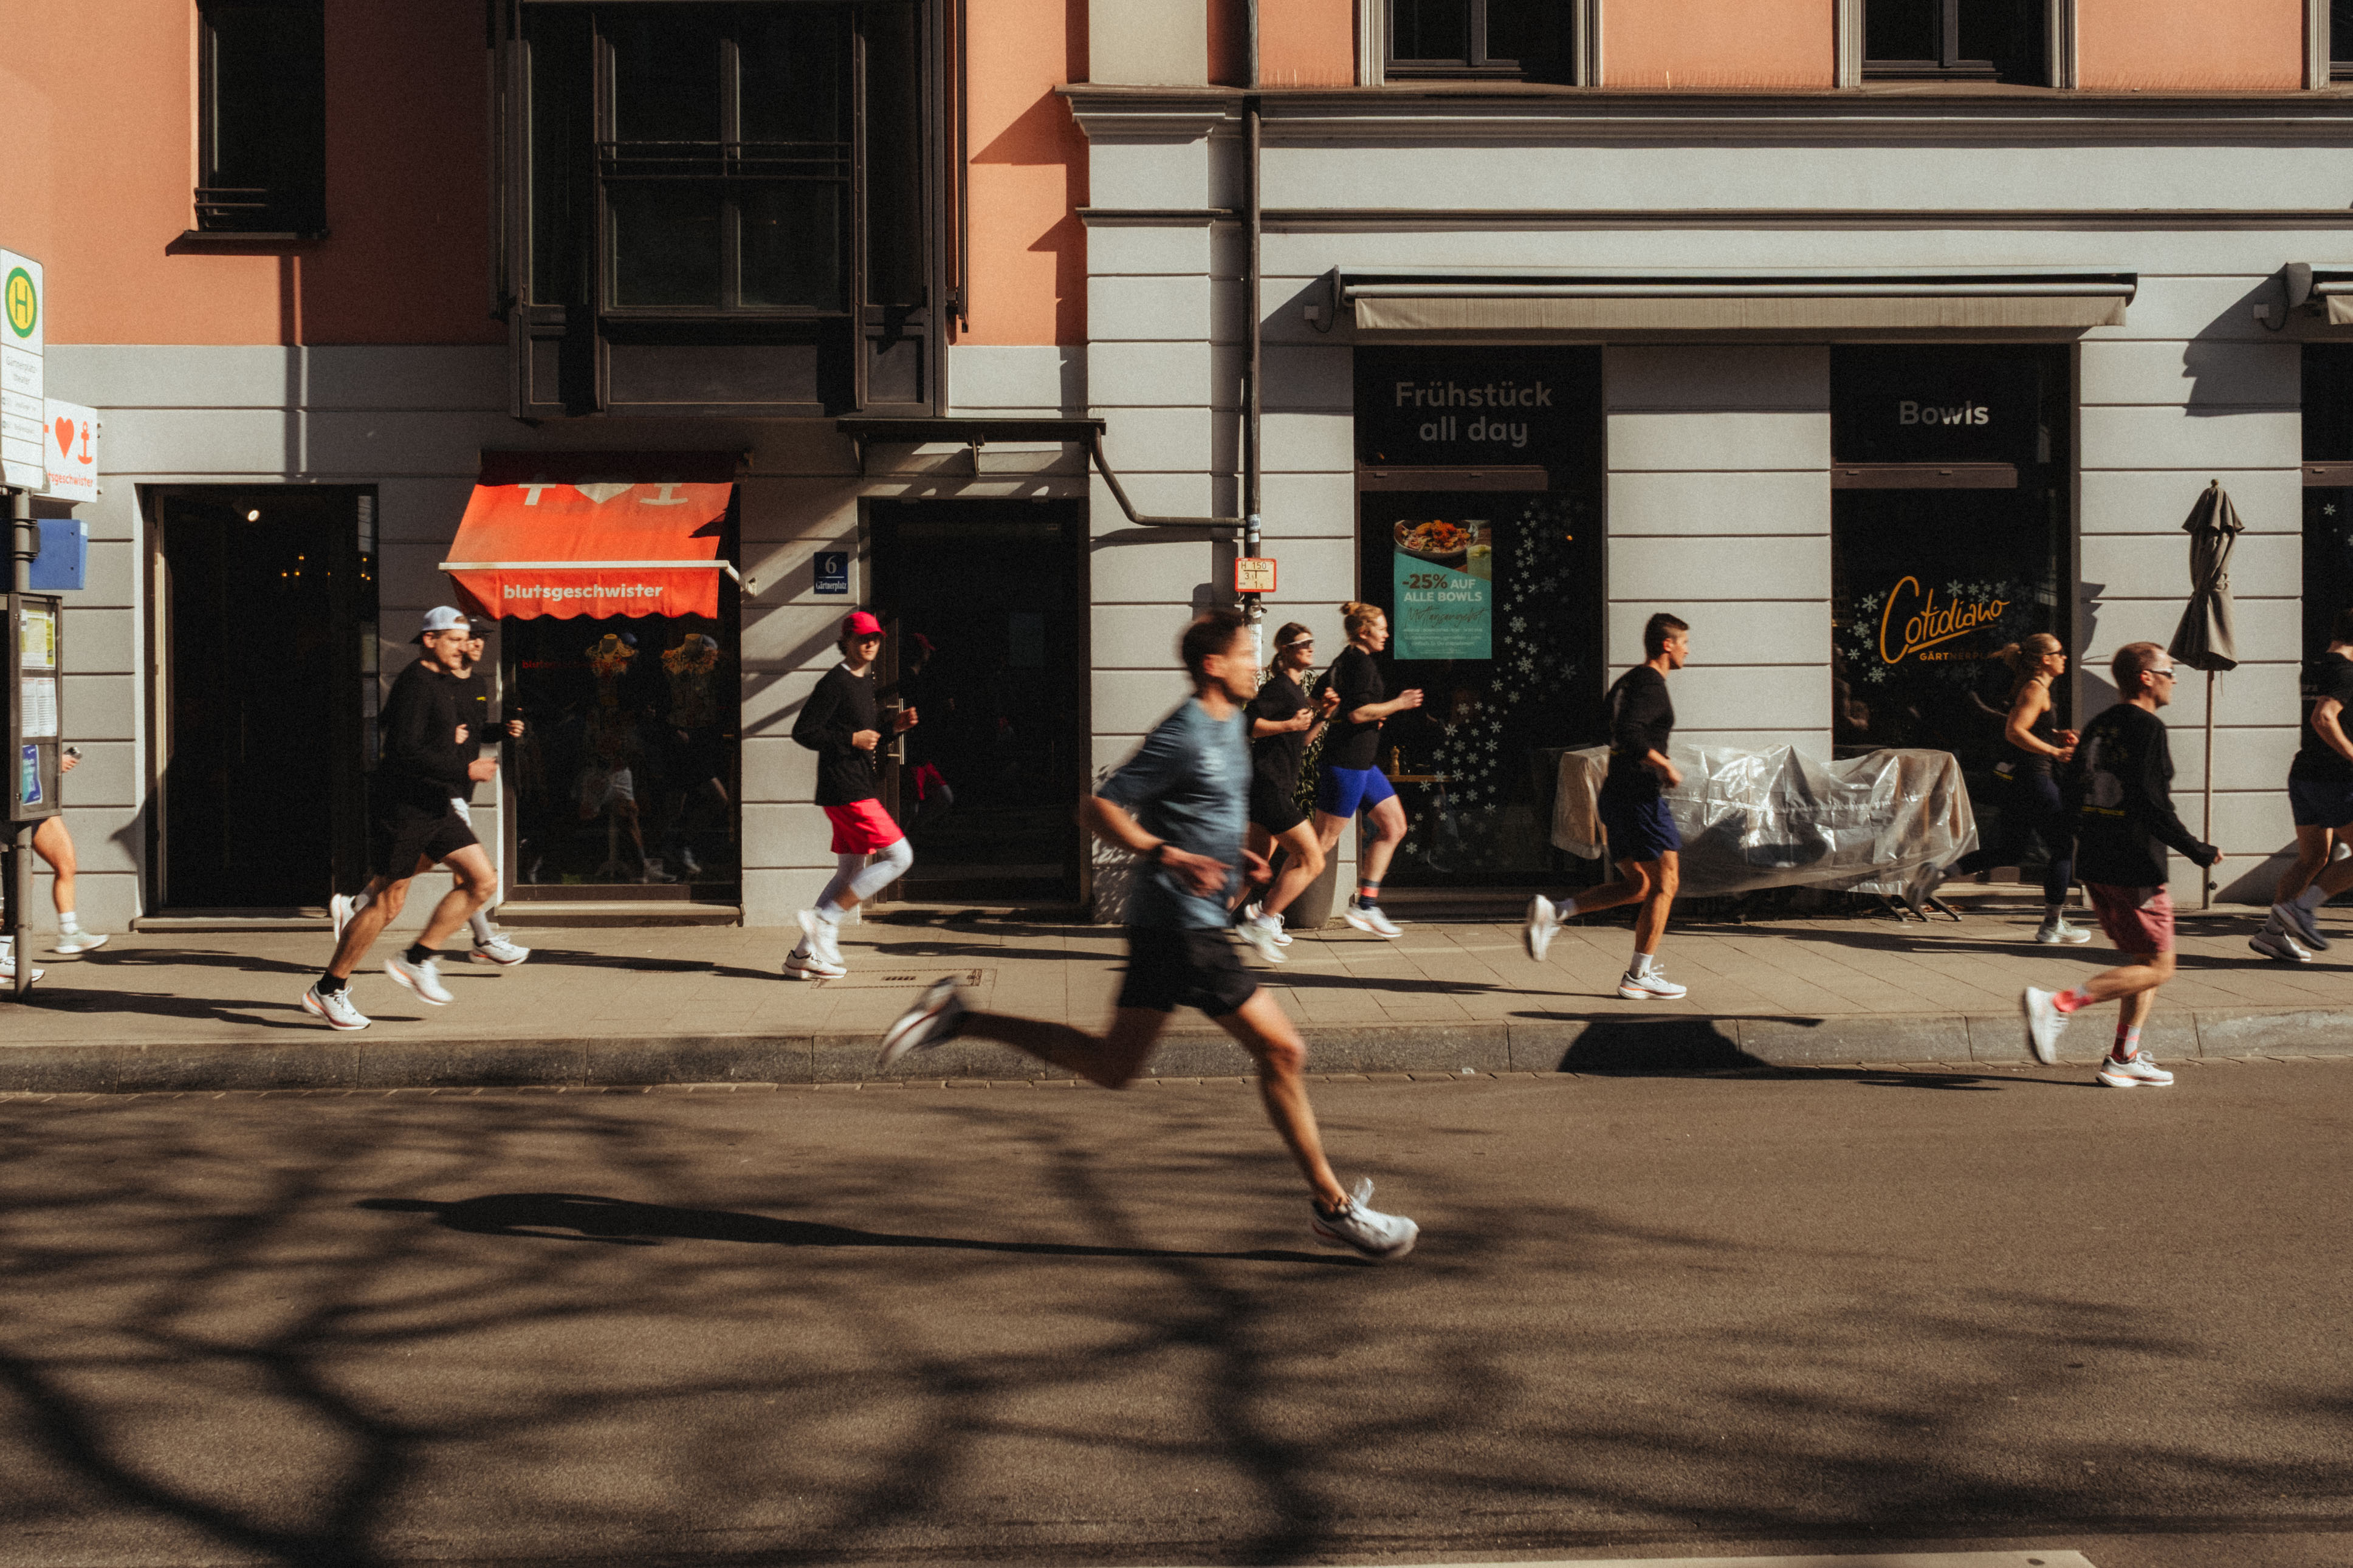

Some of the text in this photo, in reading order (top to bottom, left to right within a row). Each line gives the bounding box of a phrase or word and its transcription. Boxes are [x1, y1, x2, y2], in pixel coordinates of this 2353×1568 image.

[15, 281, 27, 323] H
[1396, 381, 1552, 407] Frühstück
[1900, 400, 1989, 425] Bowls
[1419, 416, 1527, 447] all day
[47, 471, 92, 487] tsgeschwister
[826, 555, 837, 574] 6
[816, 580, 847, 592] Gärtnerplatz
[1402, 573, 1476, 589] -25% AUF
[504, 584, 663, 601] blutsgeschwister
[1404, 592, 1482, 601] ALLE BOWLS
[1880, 576, 2010, 663] Cotidiano
[1919, 651, 1986, 660] GÄRTNERPL
